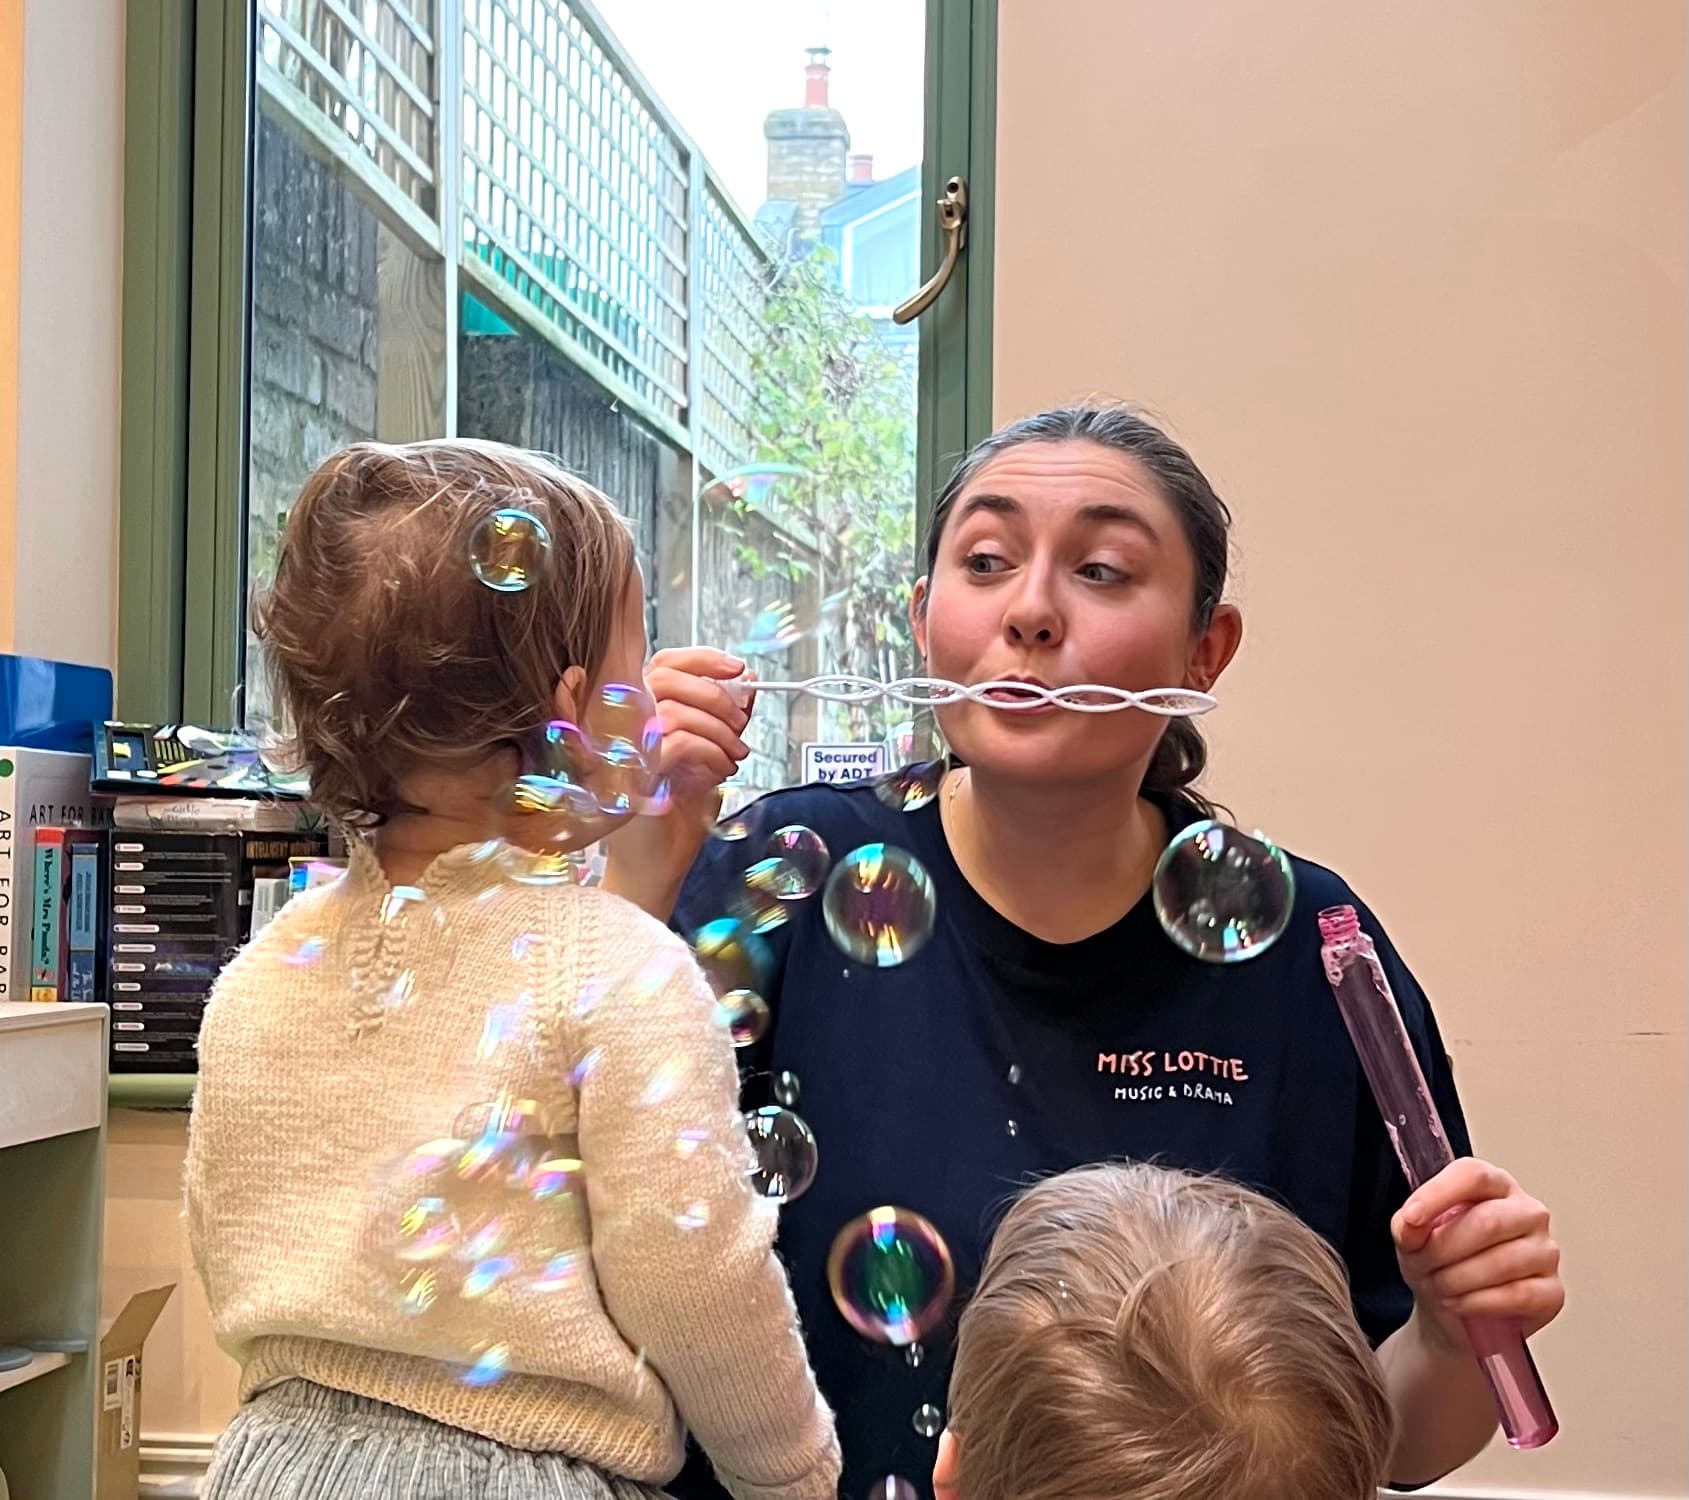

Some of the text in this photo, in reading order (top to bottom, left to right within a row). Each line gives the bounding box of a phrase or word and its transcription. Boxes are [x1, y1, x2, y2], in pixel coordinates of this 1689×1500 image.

[814, 751, 877, 763] Secured
[818, 768, 873, 781] by ADT
[29, 804, 54, 825] ART
[61, 805, 84, 825] FOR
[0, 809, 11, 859] ART
[0, 878, 10, 926] FOR
[1098, 1051, 1249, 1081] MISS LOTTIE
[1115, 1083, 1233, 1105] MUSIC & DRAMA
